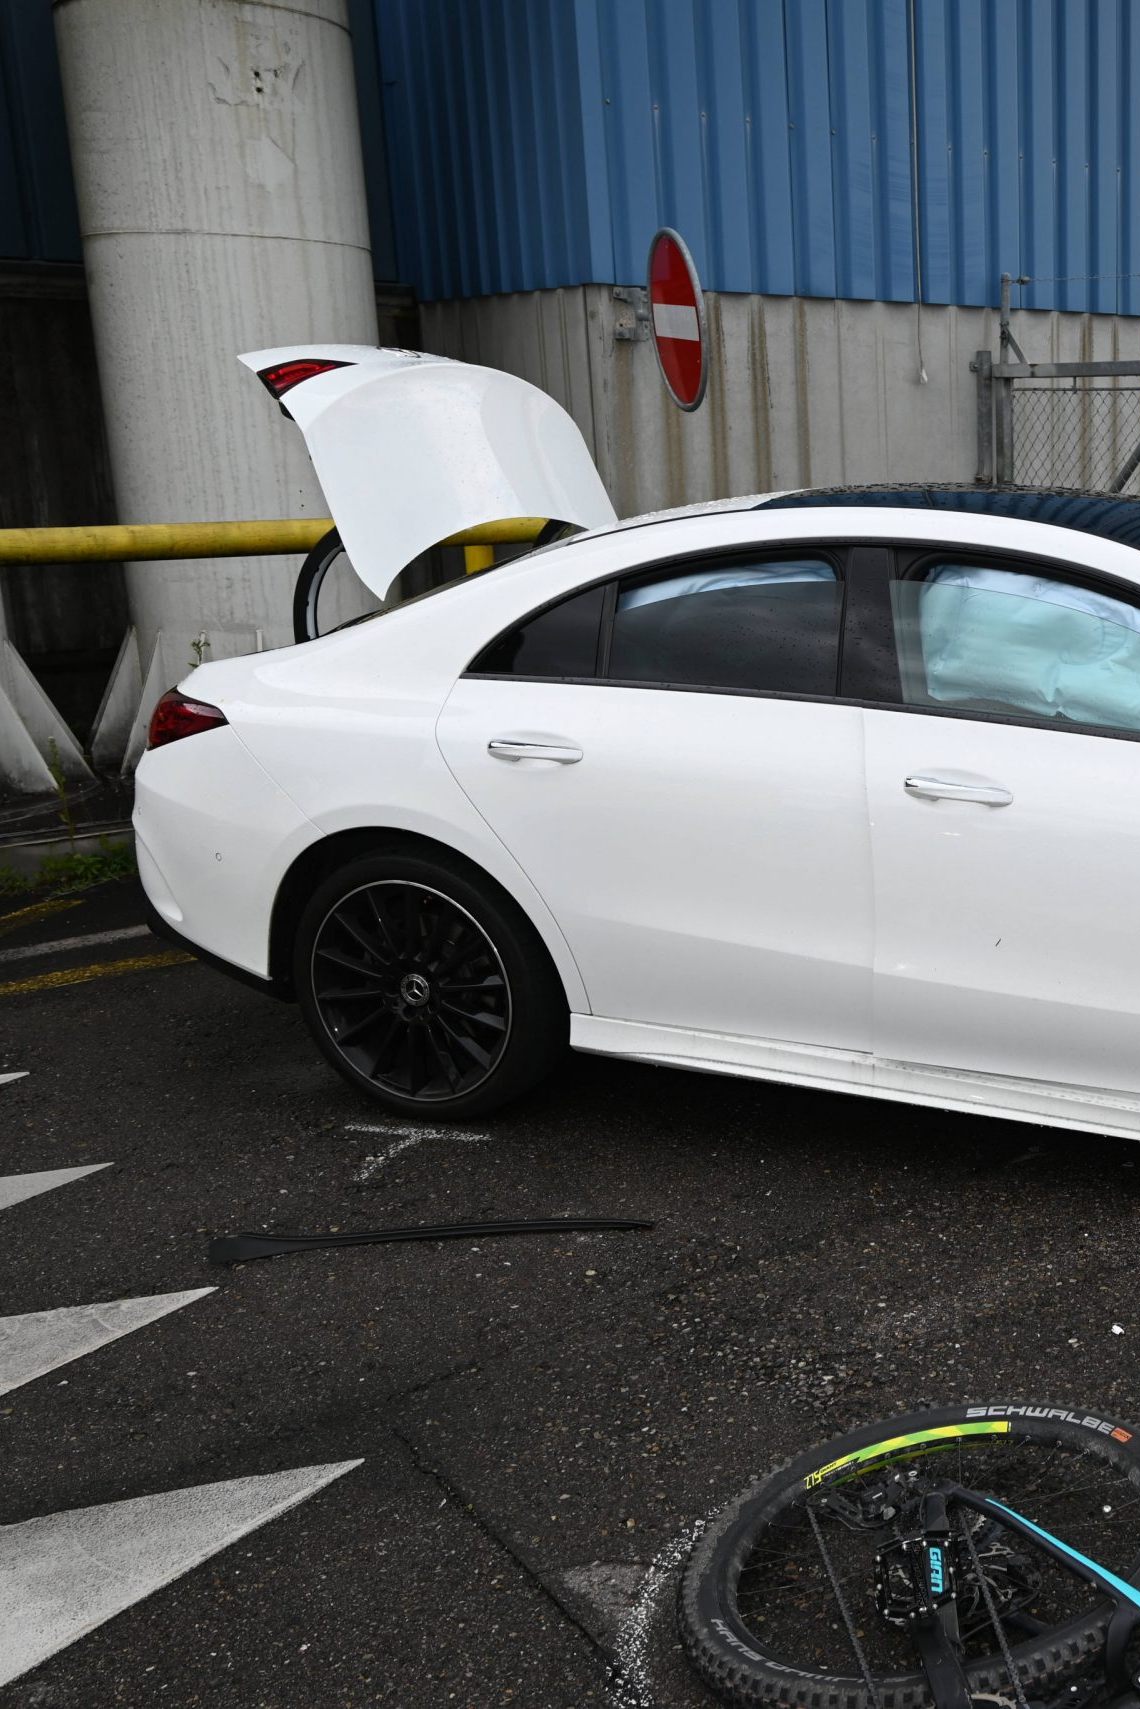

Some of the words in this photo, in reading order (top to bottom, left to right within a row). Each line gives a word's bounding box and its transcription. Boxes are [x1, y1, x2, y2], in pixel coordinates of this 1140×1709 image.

[966, 1405, 1115, 1435] SCHWALBE
[929, 1547, 943, 1594] GIAN
[711, 1618, 766, 1661] HANS
